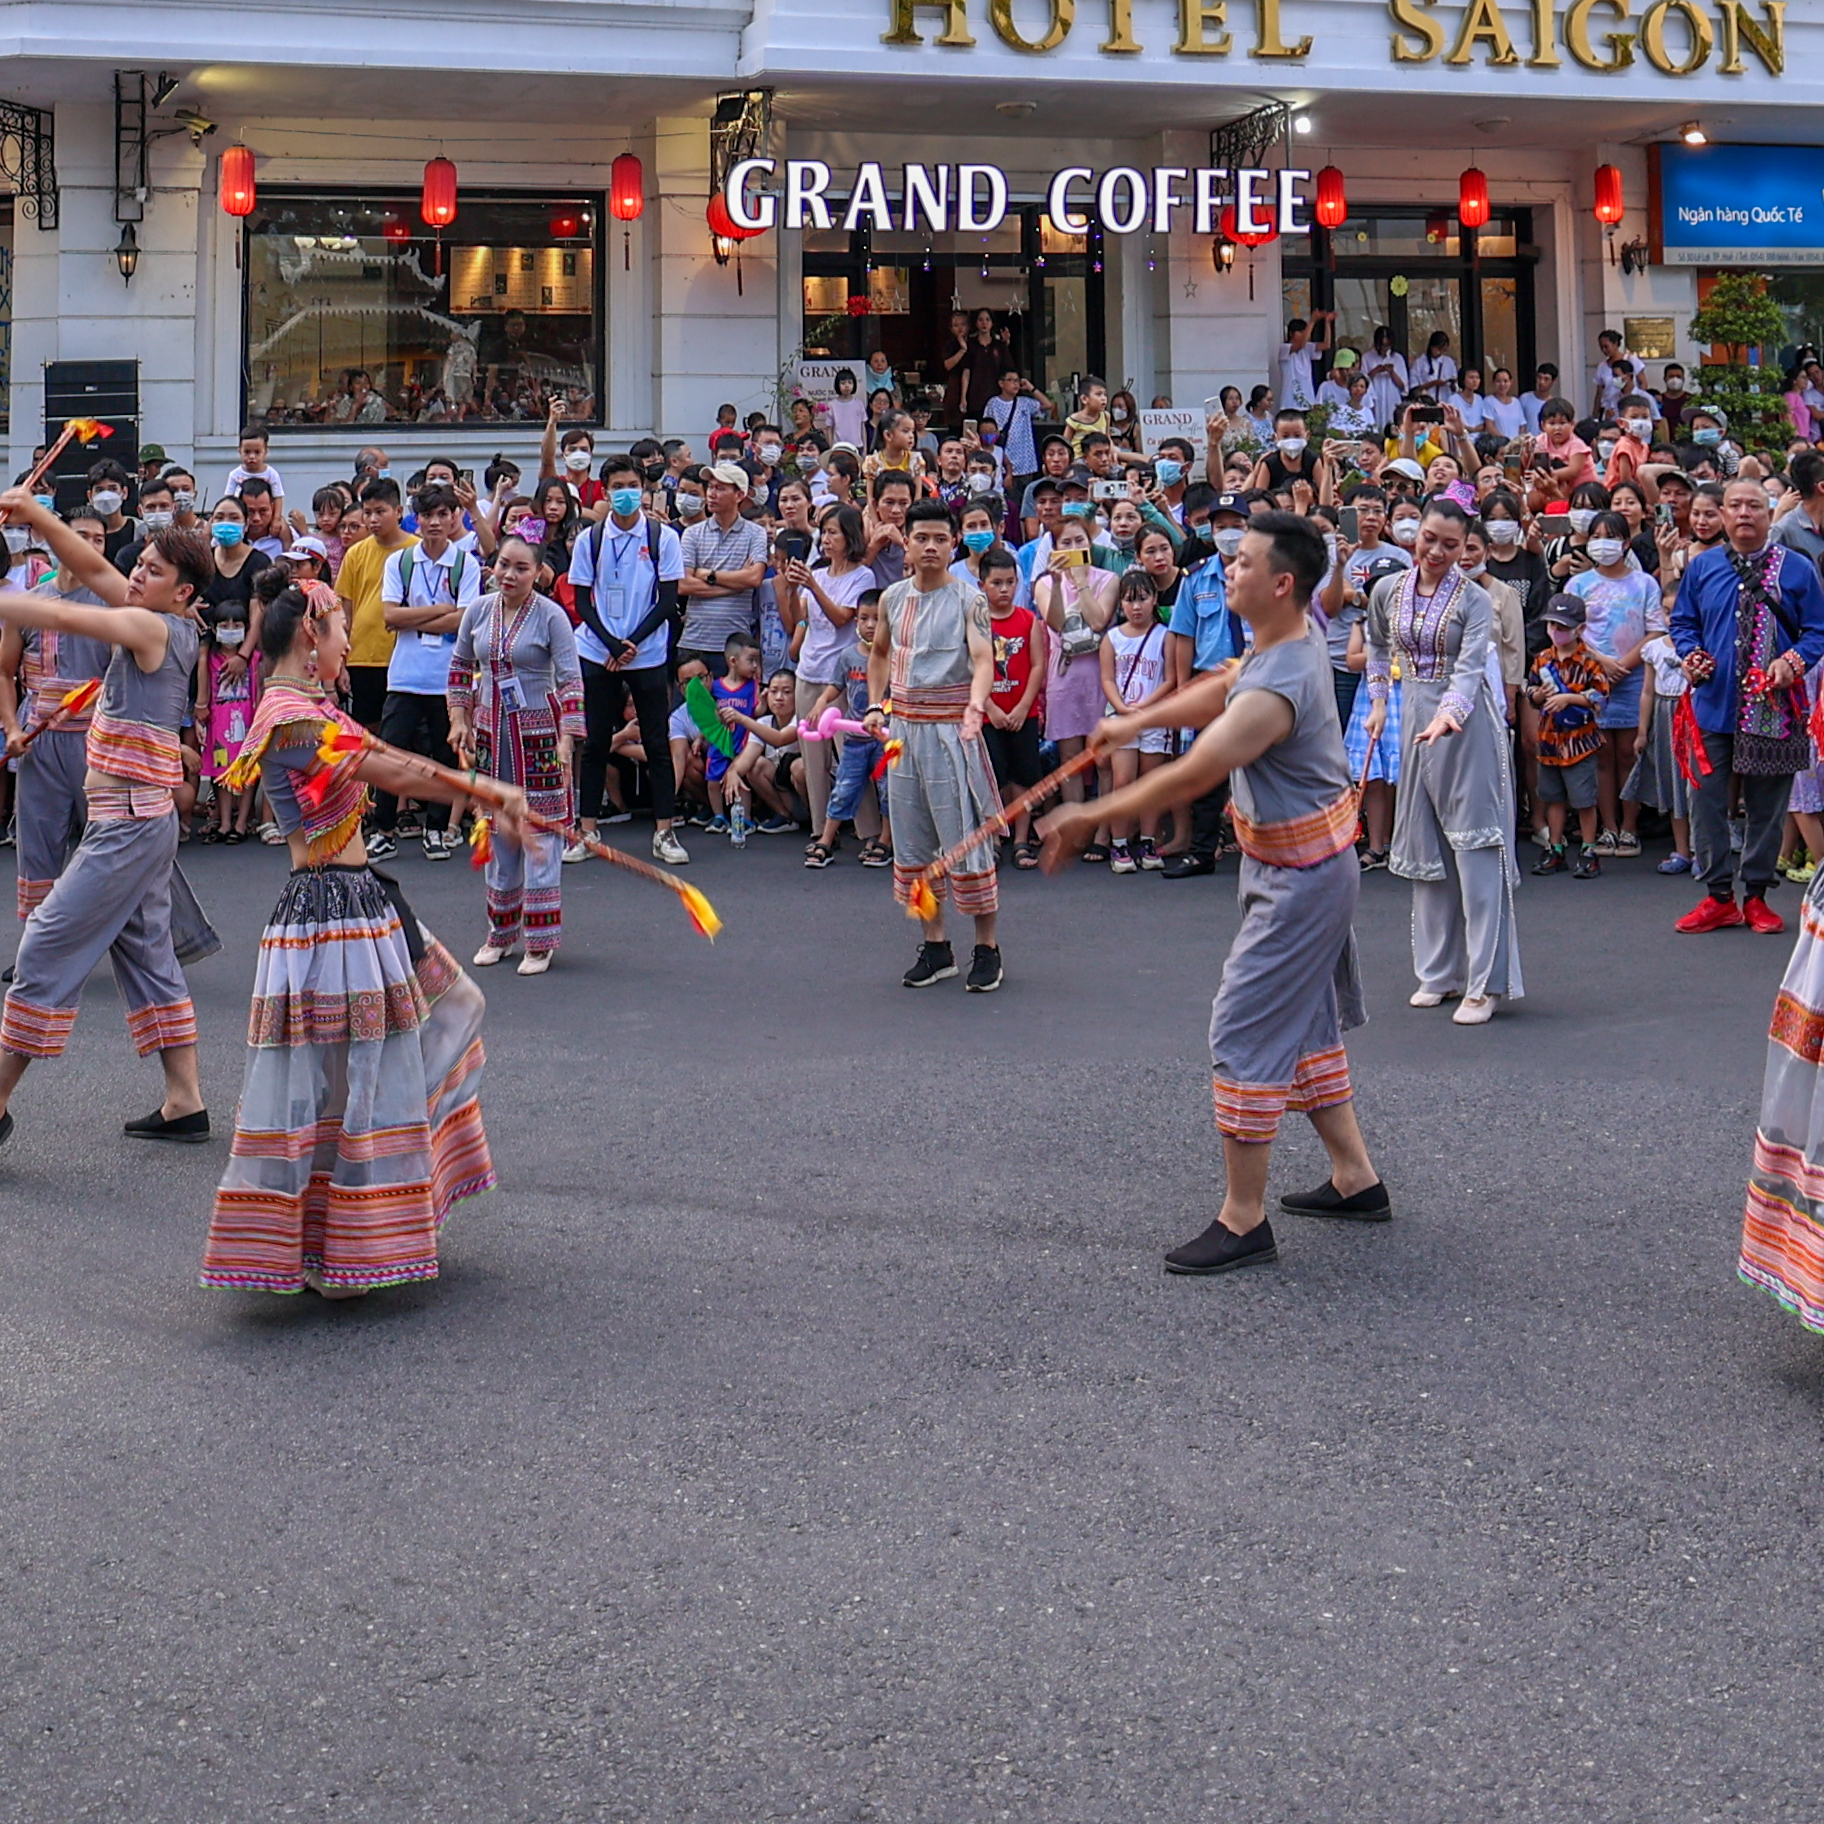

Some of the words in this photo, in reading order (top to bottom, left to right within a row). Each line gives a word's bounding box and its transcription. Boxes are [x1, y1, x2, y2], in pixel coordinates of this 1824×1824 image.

[724, 157, 1009, 234] GRAND
[1047, 166, 1313, 235] COFFEE
[1678, 206, 1713, 226] Ngân
[1716, 207, 1749, 226] hàng
[1751, 204, 1786, 224] Quốc
[1787, 206, 1804, 223] Tế
[1142, 413, 1193, 425] GRAND
